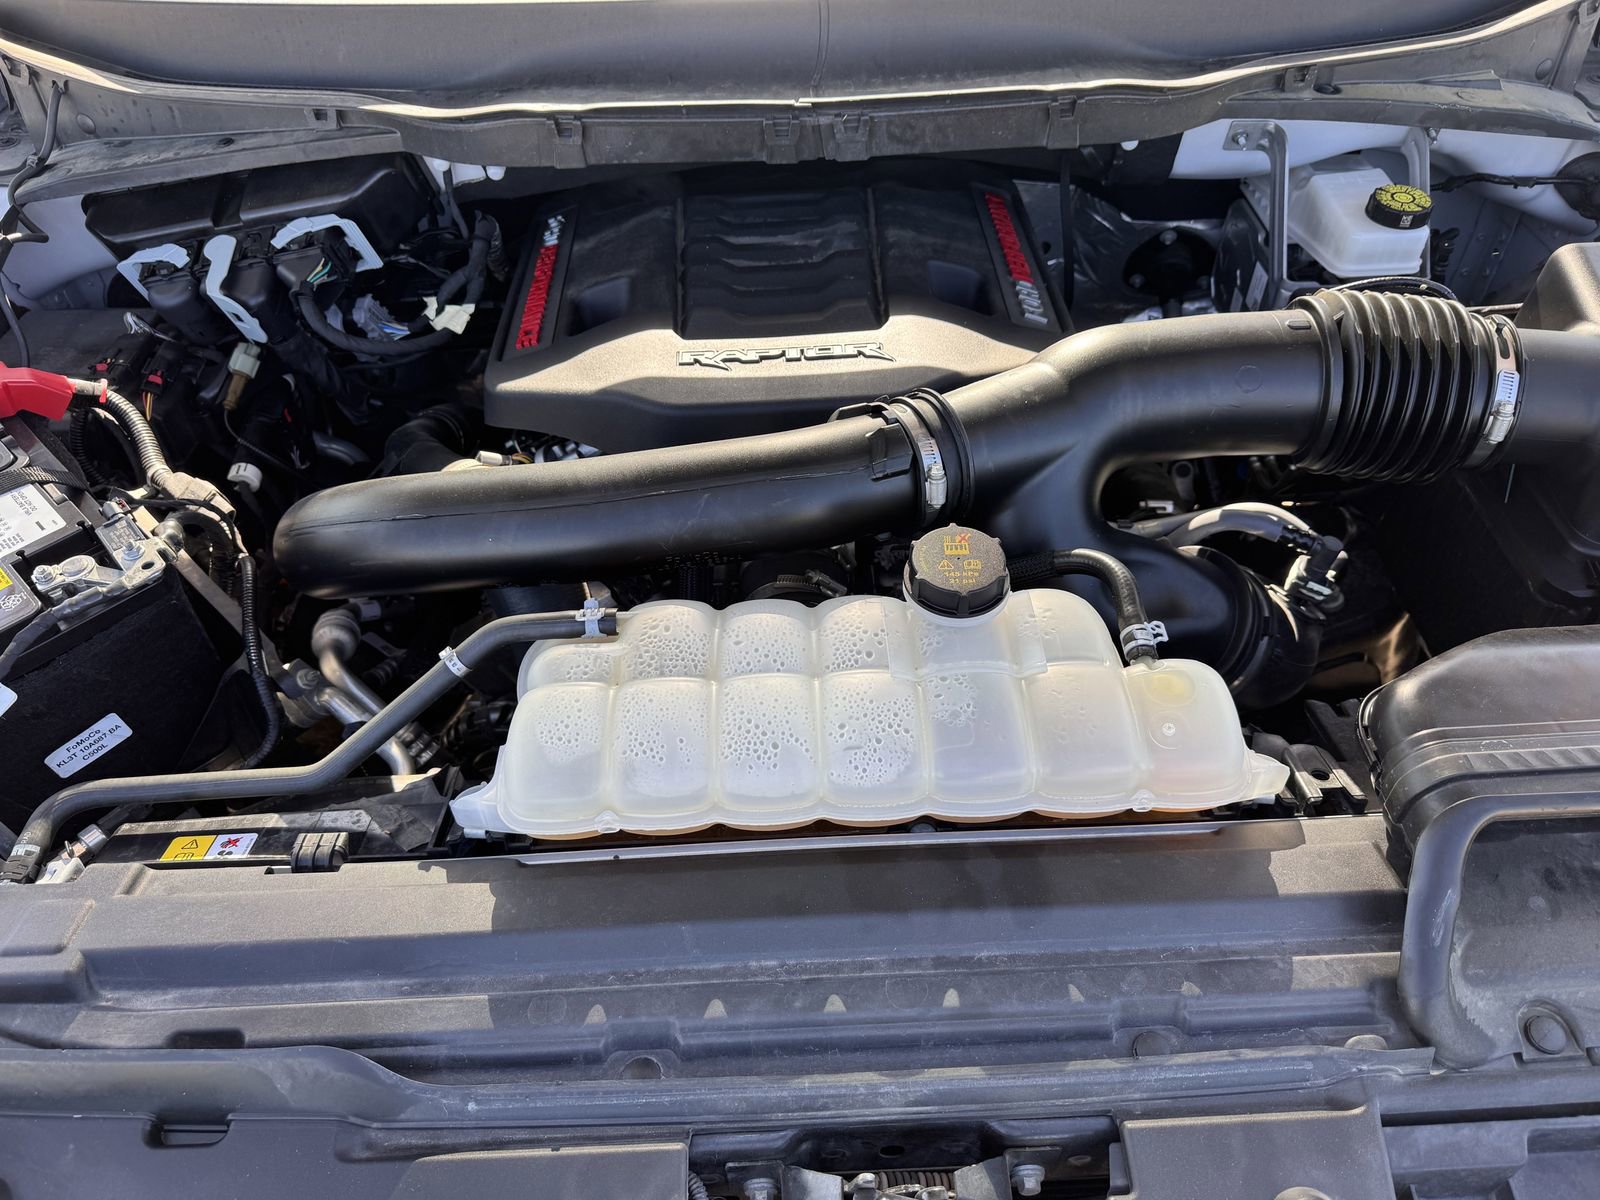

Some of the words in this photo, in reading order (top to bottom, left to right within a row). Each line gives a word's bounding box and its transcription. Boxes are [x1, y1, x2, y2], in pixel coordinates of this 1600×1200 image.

[1014, 280, 1049, 325] FORD
[676, 341, 896, 372] RAPTOR
[56, 752, 79, 768] KL3T
[79, 732, 108, 754] 10A687
[108, 724, 122, 735] BA
[65, 729, 101, 753] FoMoCo
[82, 744, 109, 761] C500L
